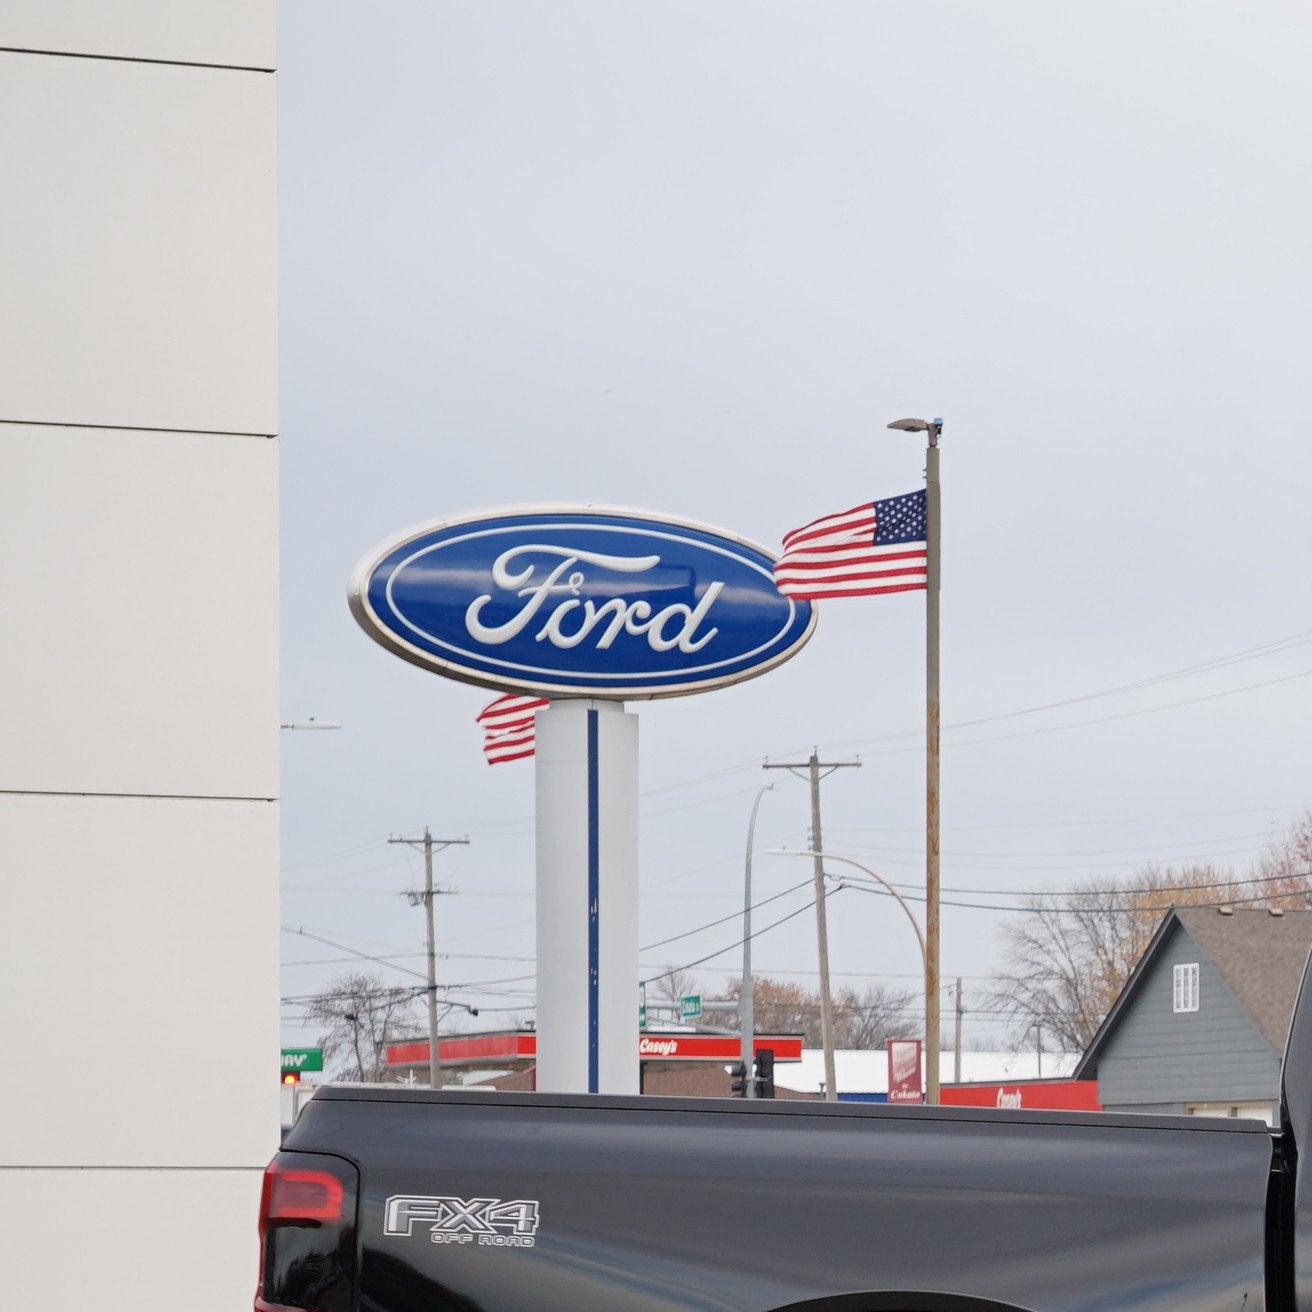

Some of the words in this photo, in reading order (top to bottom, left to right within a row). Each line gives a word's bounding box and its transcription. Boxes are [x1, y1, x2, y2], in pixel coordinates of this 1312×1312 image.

[465, 543, 725, 653] Ford
[640, 1038, 678, 1056] Casey's
[280, 1053, 308, 1067] AY
[890, 1090, 921, 1100] Cokato
[383, 1195, 540, 1236] FX4
[430, 1232, 474, 1244] OFF
[477, 1234, 535, 1248] ROAD
